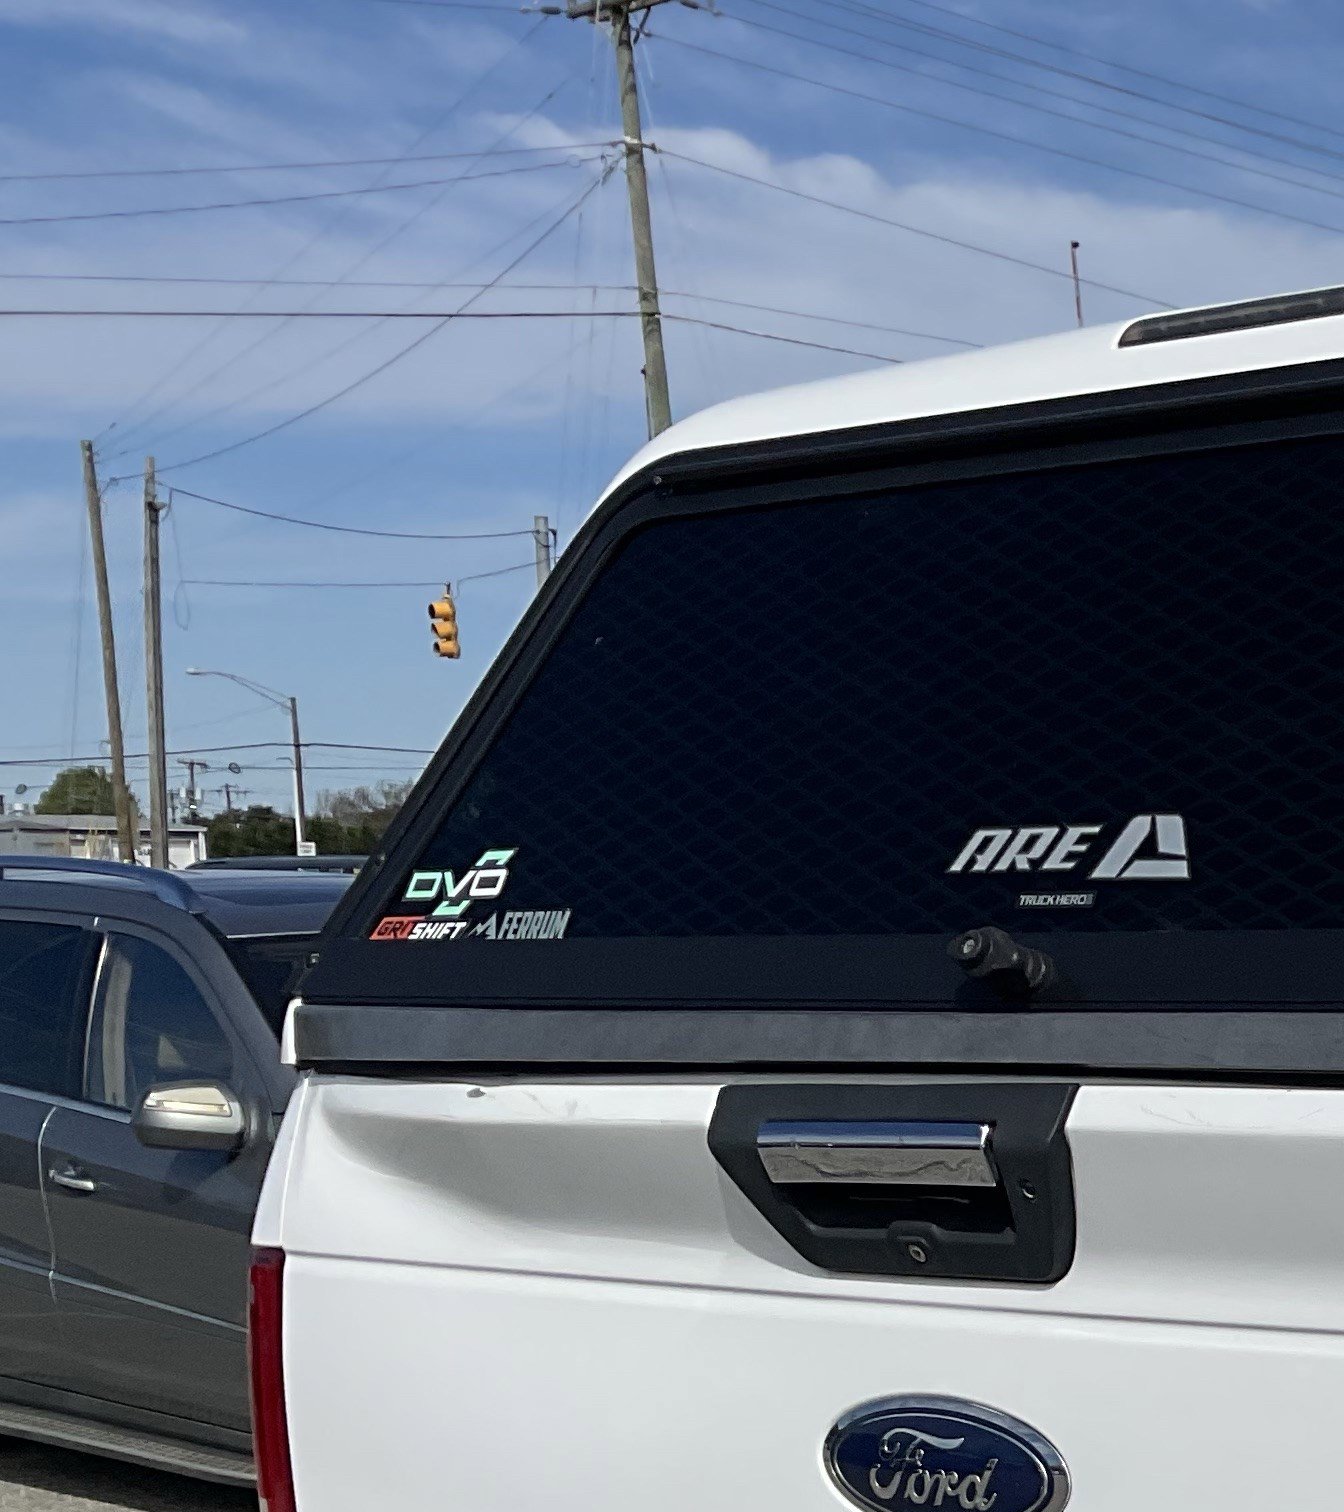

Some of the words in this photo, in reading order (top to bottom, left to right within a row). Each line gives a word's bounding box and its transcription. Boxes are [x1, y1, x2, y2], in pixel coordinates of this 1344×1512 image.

[947, 824, 1103, 873] ARE
[1019, 894, 1055, 906] TRUCK
[497, 909, 571, 940] FERRUM
[868, 1427, 999, 1512] Ford
